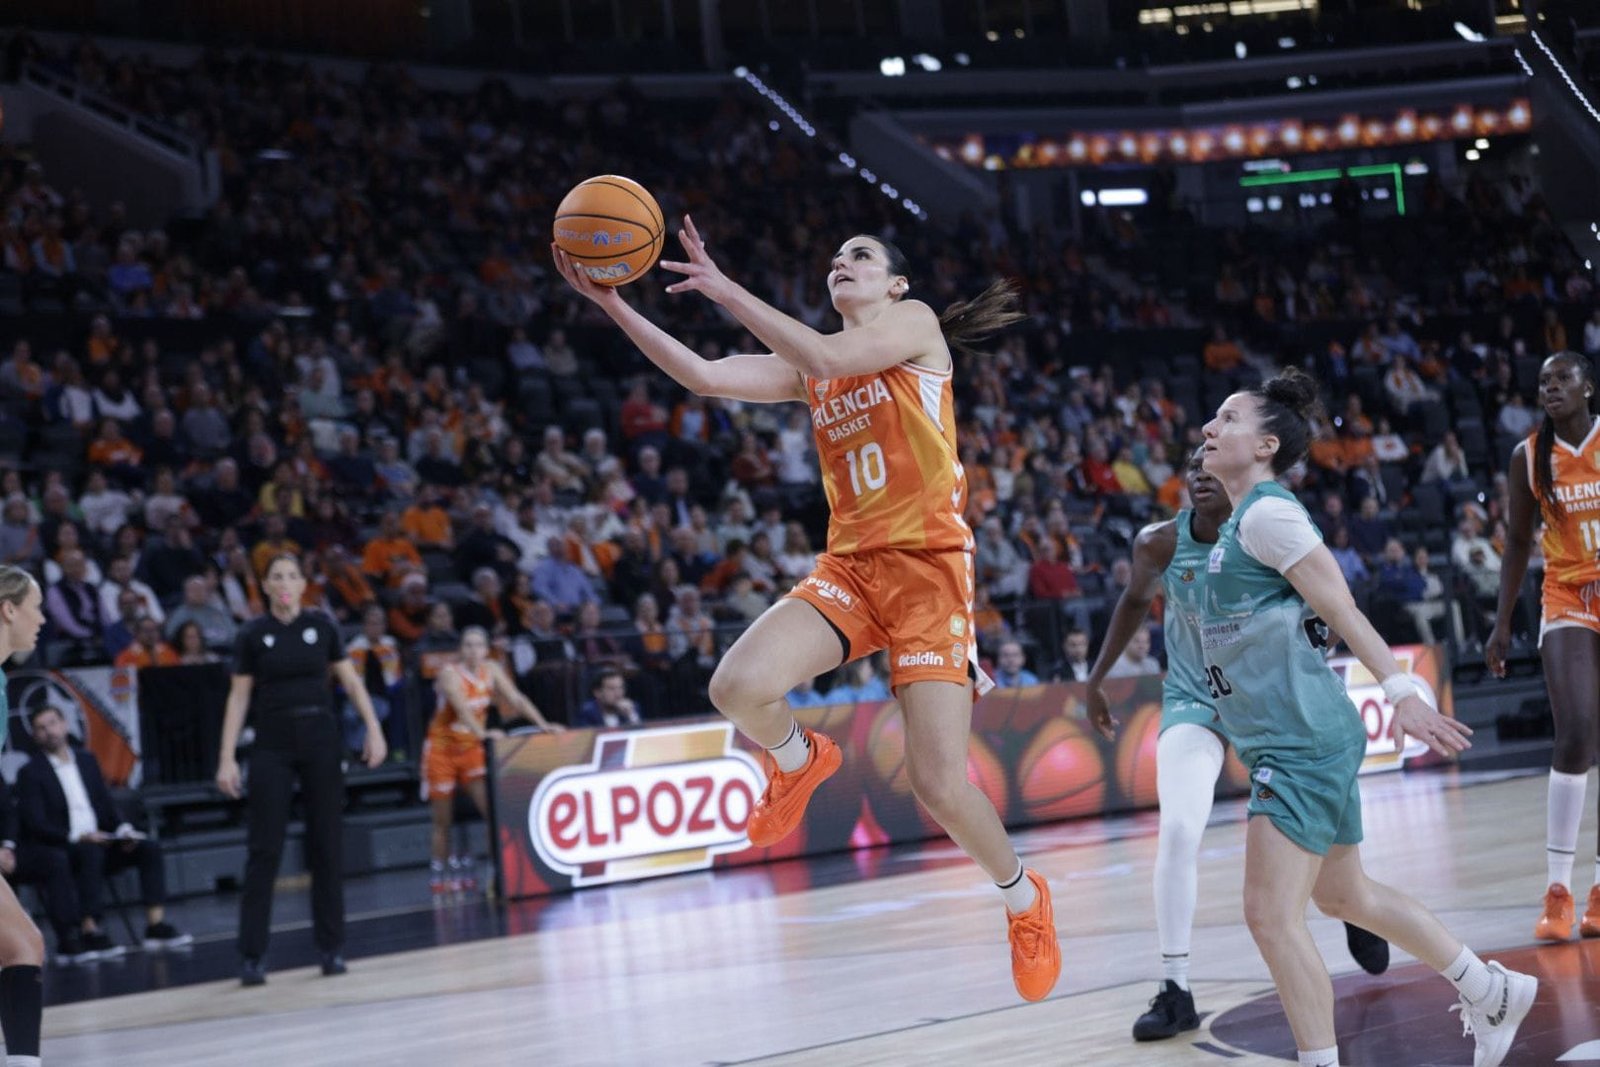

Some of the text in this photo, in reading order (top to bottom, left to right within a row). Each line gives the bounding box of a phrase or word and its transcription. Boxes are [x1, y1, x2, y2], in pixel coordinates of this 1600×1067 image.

[827, 413, 872, 442] BASKET
[846, 442, 887, 497] 10
[806, 577, 852, 605] PULEVA
